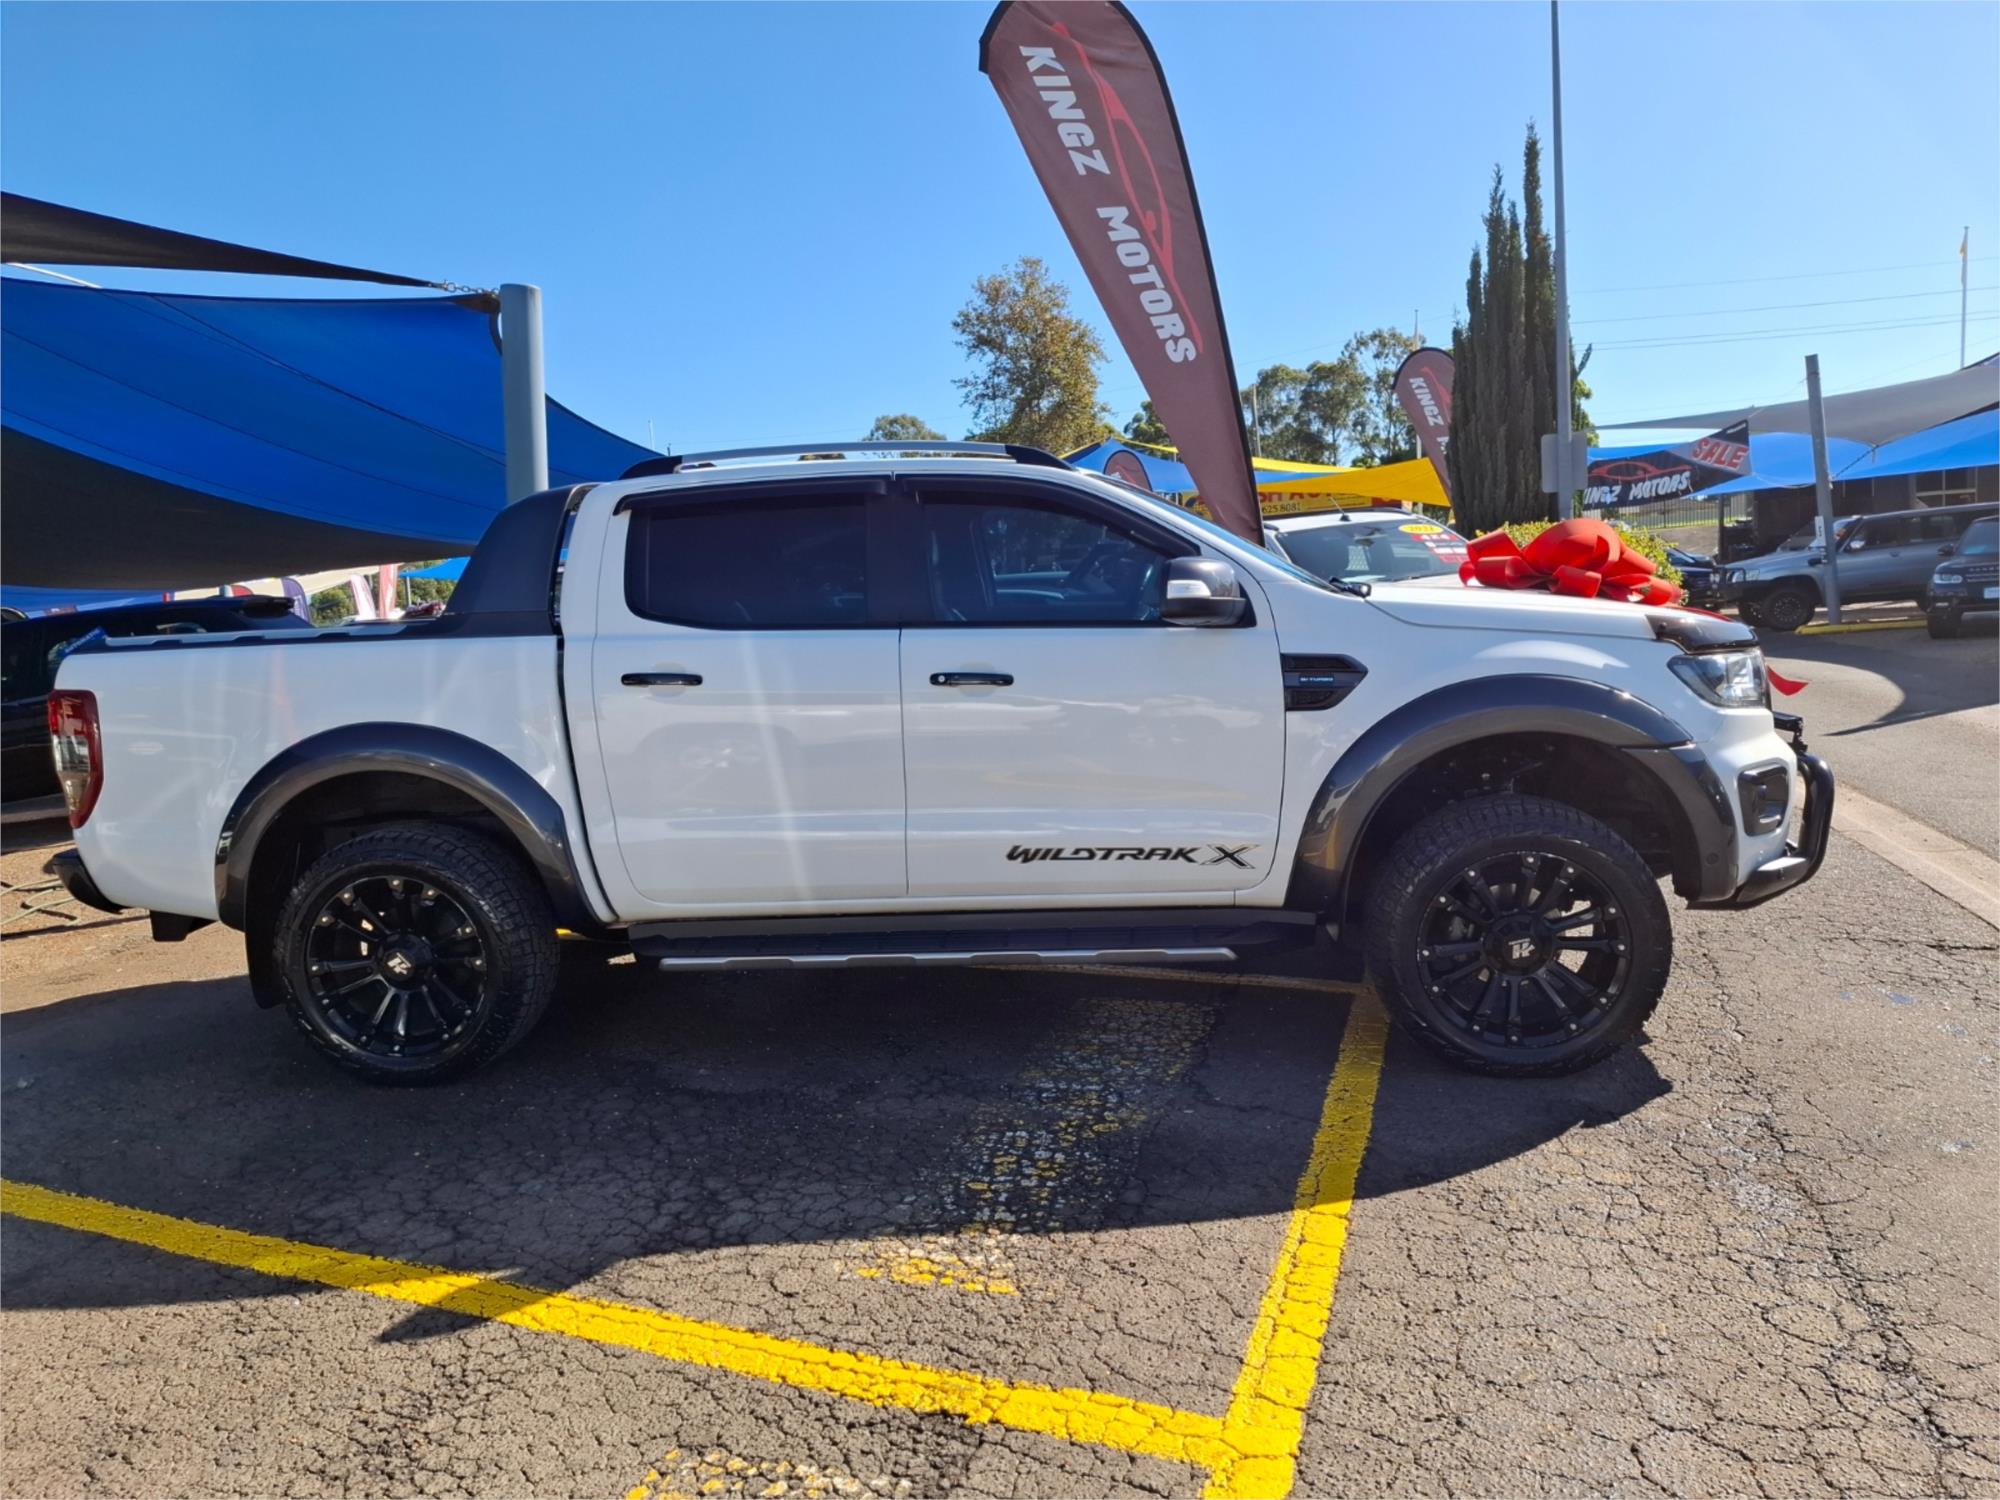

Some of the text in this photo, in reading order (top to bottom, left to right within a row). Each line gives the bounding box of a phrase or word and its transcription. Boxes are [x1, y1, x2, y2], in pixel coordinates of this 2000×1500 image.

[1019, 46, 1196, 363] KINGZ MOTORS
[1408, 377, 1444, 426] KINGZ
[1692, 438, 1749, 469] SALE
[1583, 471, 1690, 504] INGZ MOTORS
[1006, 843, 1260, 869] WILDTRAK X
